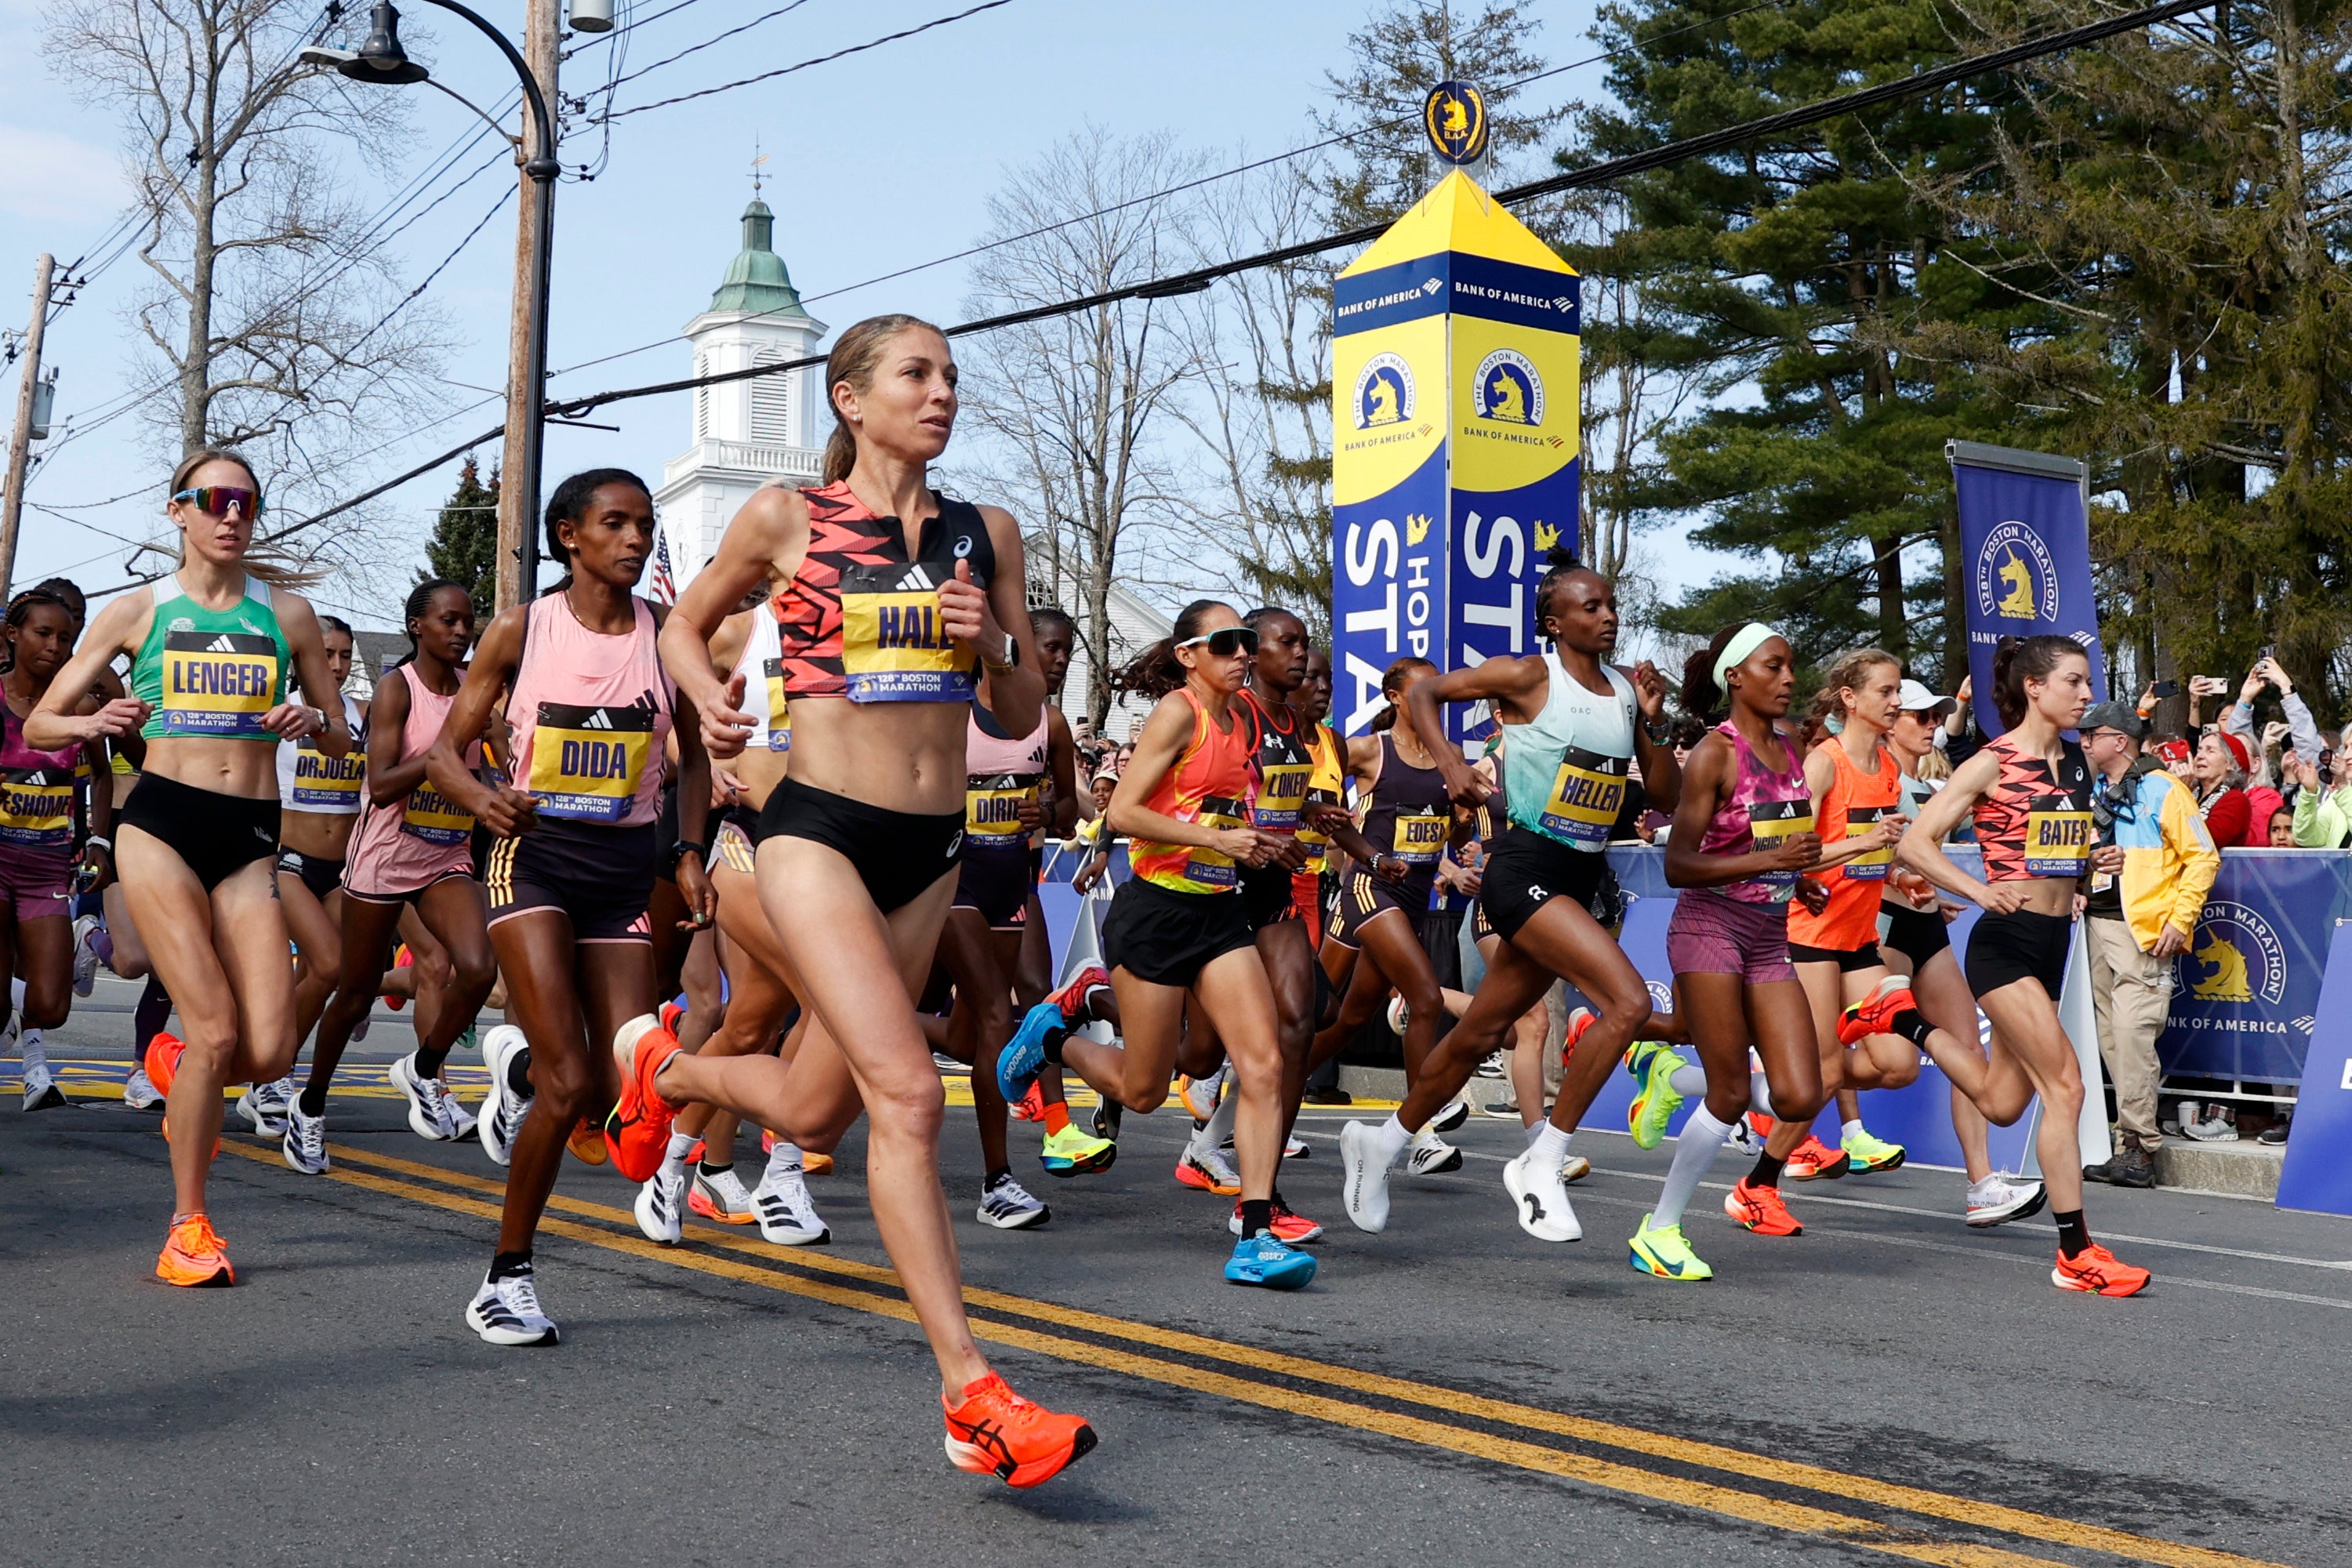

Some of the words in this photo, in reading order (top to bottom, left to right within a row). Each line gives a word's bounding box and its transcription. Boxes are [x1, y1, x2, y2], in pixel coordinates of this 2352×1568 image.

[1338, 302, 1363, 318] BANK
[1365, 299, 1377, 310] OF
[1378, 288, 1421, 307] AMERICA
[1455, 281, 1485, 296] BANK
[1487, 289, 1501, 299] OF
[1503, 292, 1552, 310] AMERICA
[1358, 358, 1385, 390] BOSTON
[1389, 357, 1414, 411] MARATHON
[1479, 353, 1512, 378] BOSTON
[1516, 356, 1542, 417] MARATHON
[1345, 440, 1366, 452] BANK
[1368, 438, 1378, 447] OF
[1380, 431, 1416, 445] AMERICA
[1463, 426, 1488, 438] BANK
[1490, 431, 1502, 440] OF
[1504, 434, 1544, 447] AMERICA
[1984, 526, 2019, 562] BOSTON
[2024, 530, 2055, 612] MARATHON
[1980, 566, 1991, 608] 128TH
[1407, 556, 1429, 657] HOP
[877, 605, 955, 650] HALL
[1345, 518, 1399, 738] STA
[1971, 631, 1998, 644] BANK
[173, 660, 268, 697] LENGER
[879, 683, 942, 691] MARATHON
[901, 674, 941, 683] BOSTON
[296, 755, 365, 781] ORJUELA
[560, 739, 627, 779] DIDA
[554, 802, 612, 814] MARATHON
[575, 797, 611, 807] BOSTON
[1559, 774, 1622, 813] HELLEN
[1406, 822, 1446, 843] EDESA
[2039, 819, 2088, 847] BATES
[2234, 909, 2282, 995] MARATHON
[2167, 1017, 2187, 1029] NK
[2191, 1018, 2211, 1029] OF
[2214, 1019, 2288, 1033] AMERICA
[1004, 1044, 1028, 1083] BROOKS
[1357, 1160, 1364, 1174] ON
[1352, 1174, 1363, 1213] RUNNING
[1257, 1251, 1288, 1261] BROOKS
